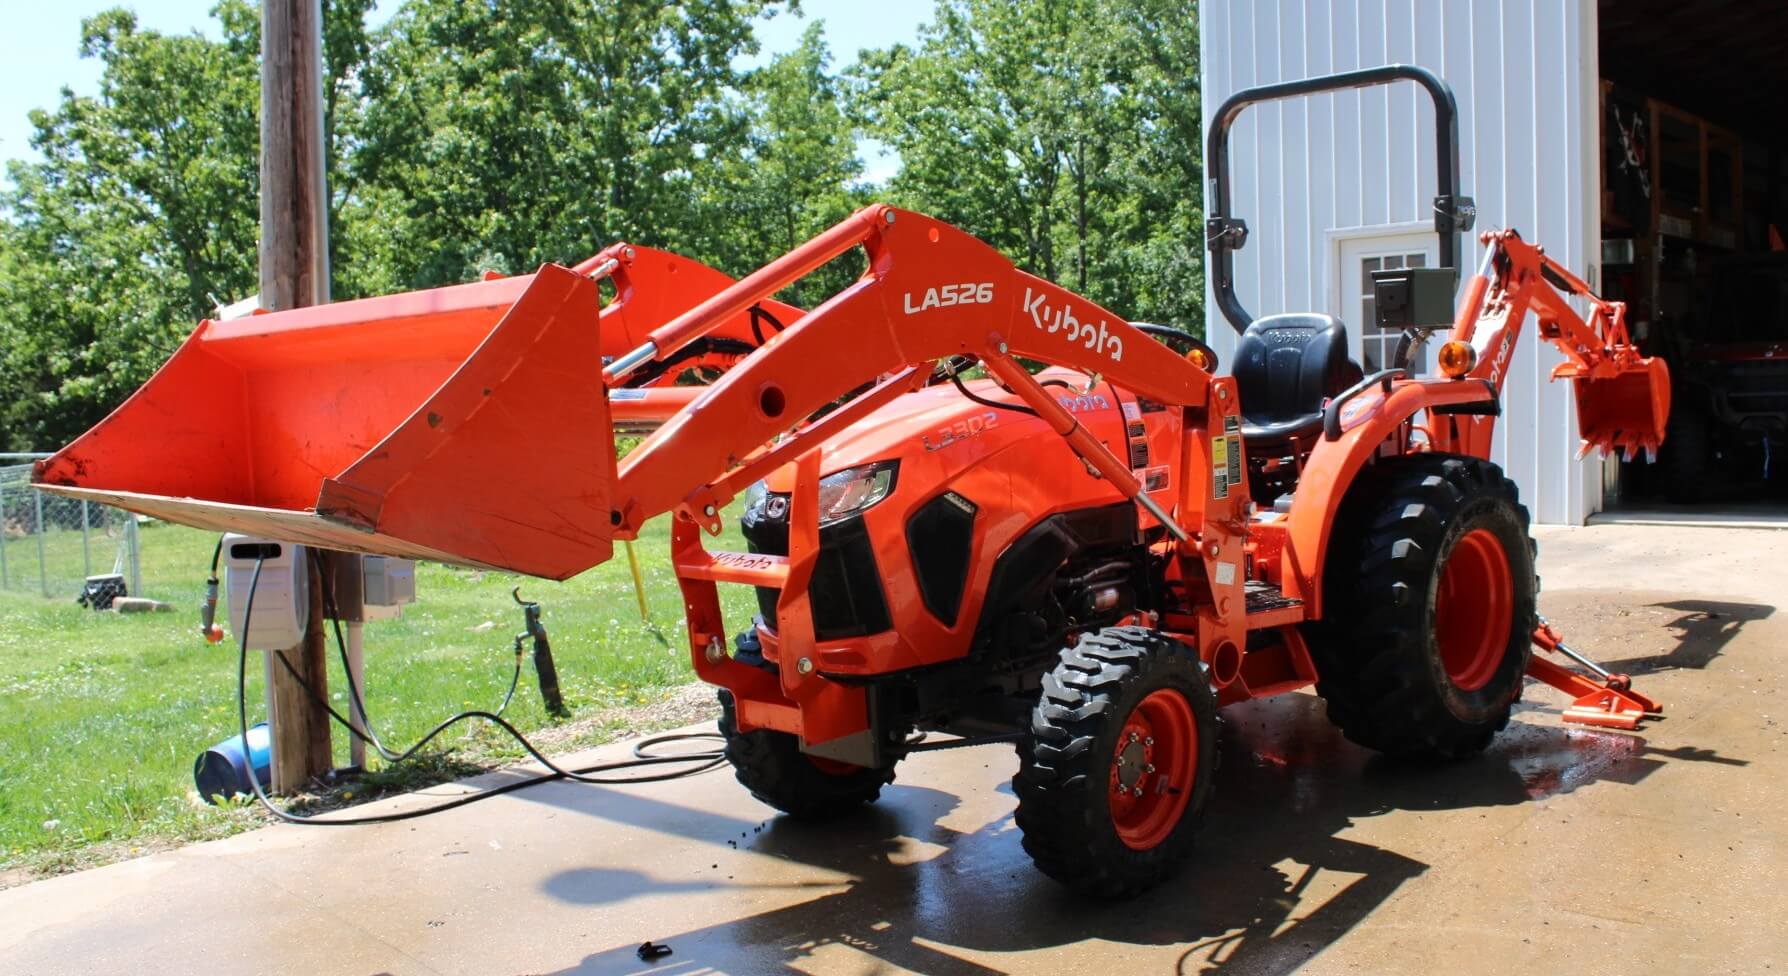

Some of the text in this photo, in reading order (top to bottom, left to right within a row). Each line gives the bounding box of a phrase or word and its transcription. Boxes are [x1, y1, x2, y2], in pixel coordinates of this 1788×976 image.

[904, 283, 994, 314] LA526
[1023, 287, 1123, 361] Kubota
[1268, 330, 1312, 344] Kubota
[712, 553, 772, 569] Kubota
